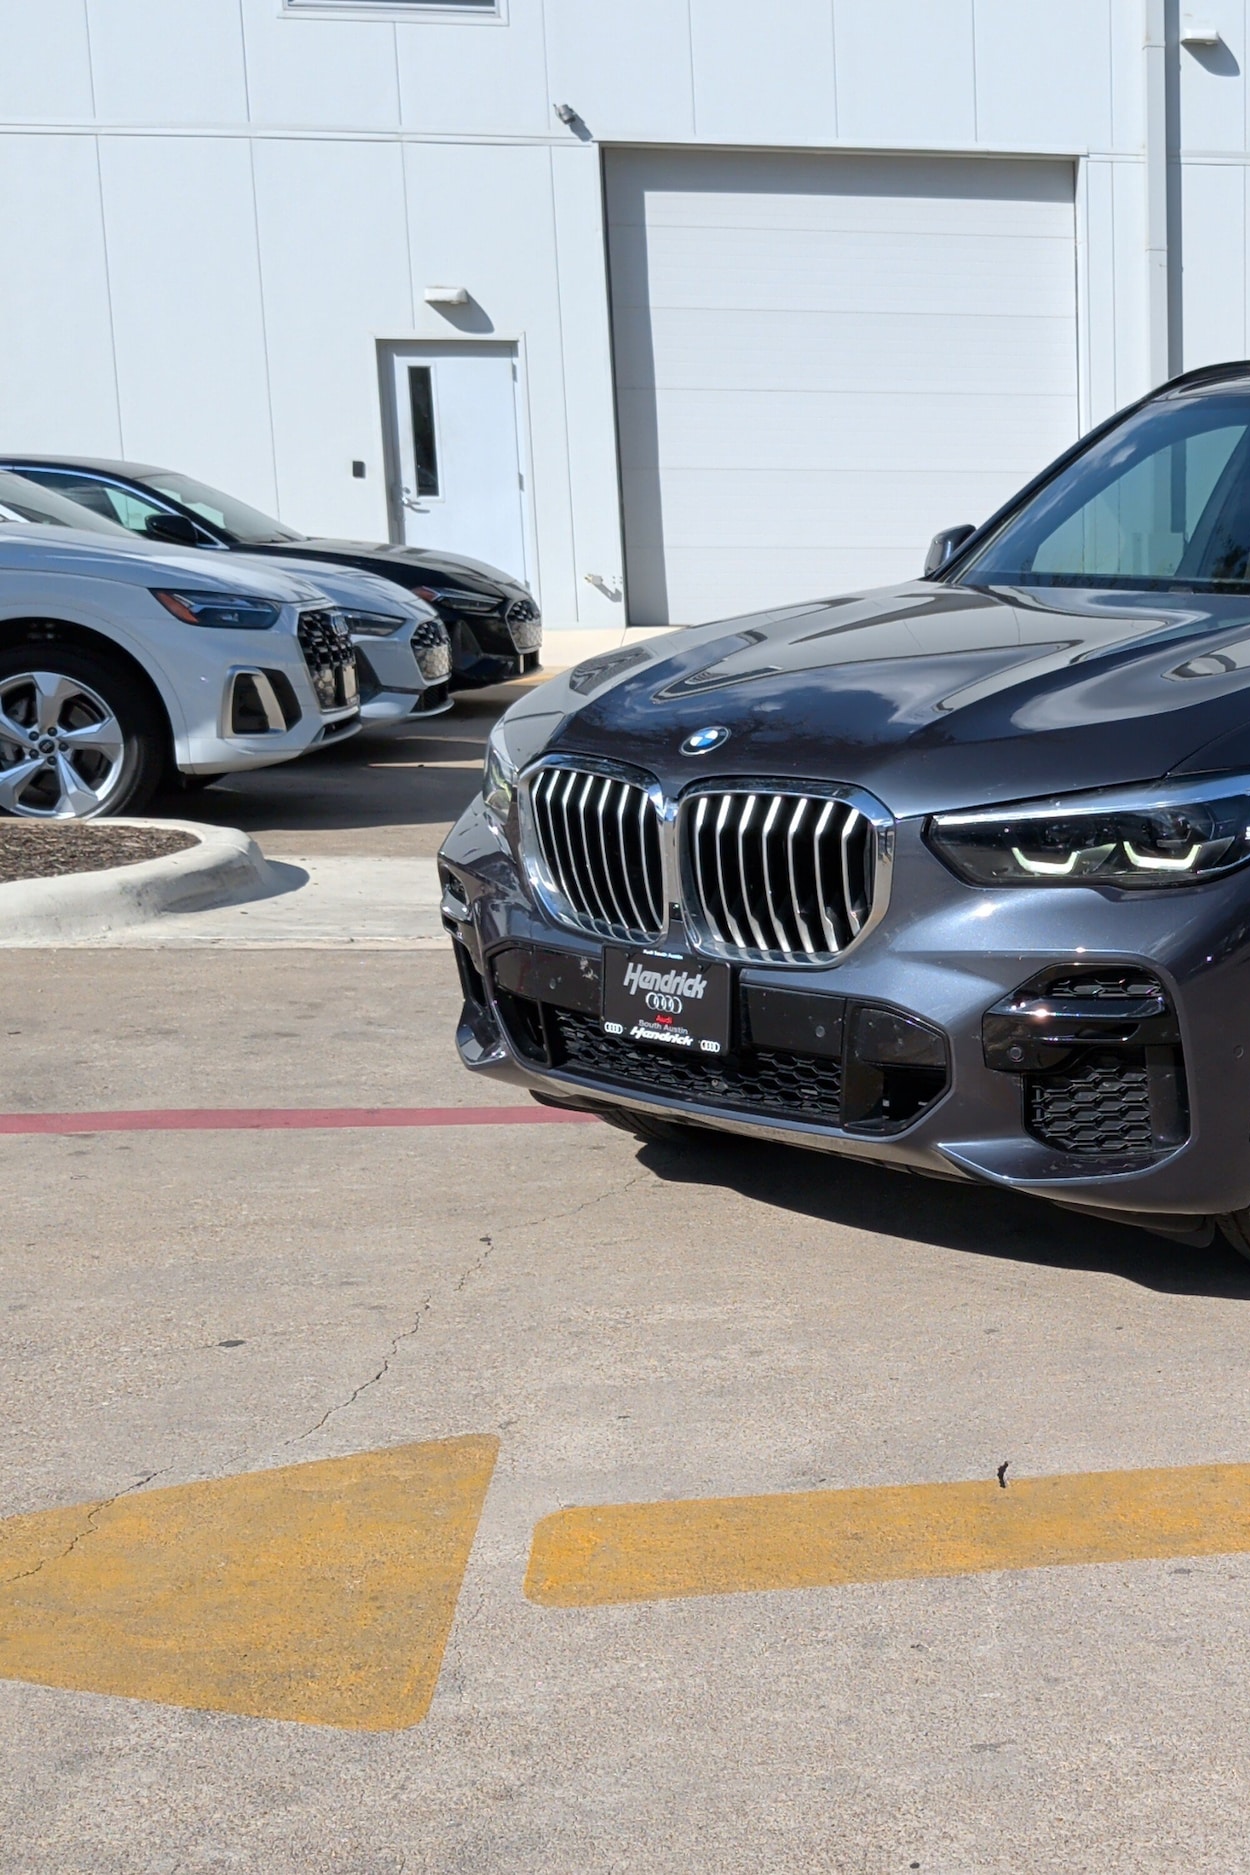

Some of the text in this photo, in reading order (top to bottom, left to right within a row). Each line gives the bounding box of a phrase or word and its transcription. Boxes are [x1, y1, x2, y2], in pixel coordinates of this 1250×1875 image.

[623, 962, 707, 999] Hendrick
[638, 1019, 688, 1034] South Austin
[656, 1015, 673, 1024] Audi
[630, 1026, 693, 1046] Hendrick
